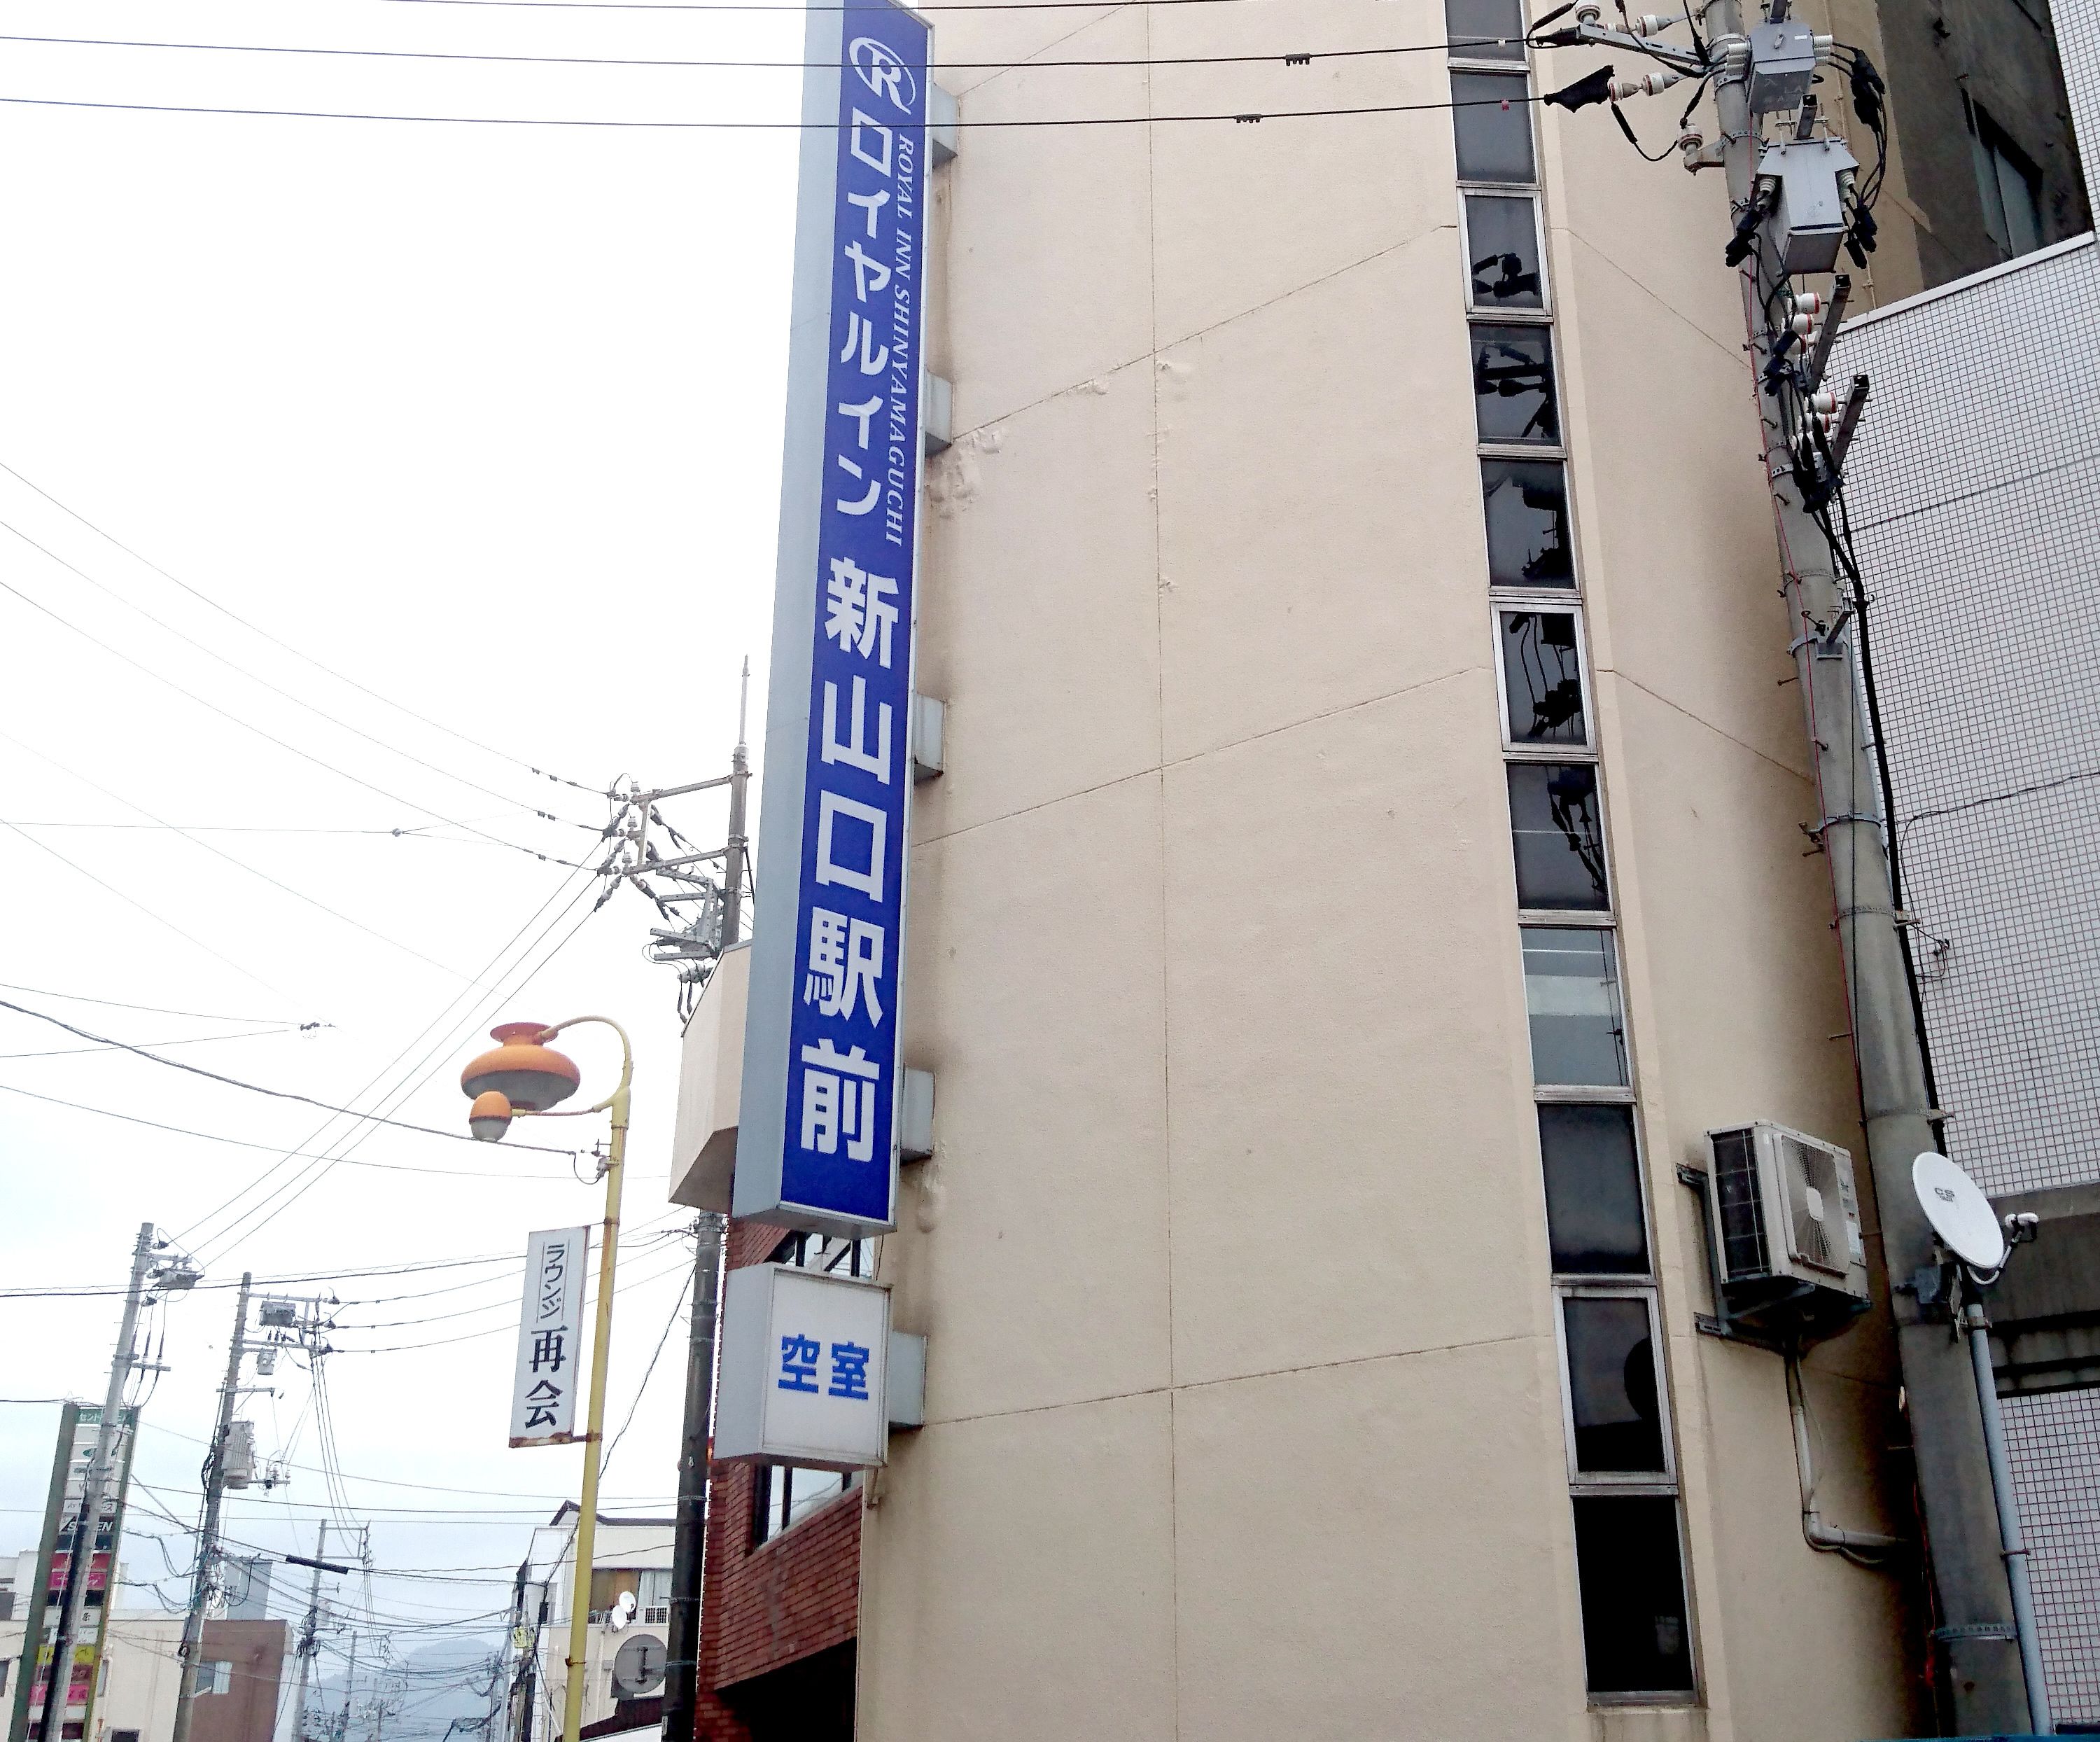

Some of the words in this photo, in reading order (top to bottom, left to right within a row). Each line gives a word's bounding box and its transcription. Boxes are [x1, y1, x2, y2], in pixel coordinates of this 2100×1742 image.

[897, 132, 915, 219] ROYAL
[895, 228, 913, 281] INN
[836, 106, 892, 516] ロイヤルイン
[885, 284, 910, 546] SHINYAMAGUCHI
[800, 556, 899, 1163] 新山口駅前
[540, 1243, 565, 1320] ラウンジ
[525, 1325, 568, 1430] 再会
[778, 1333, 869, 1401] 空室
